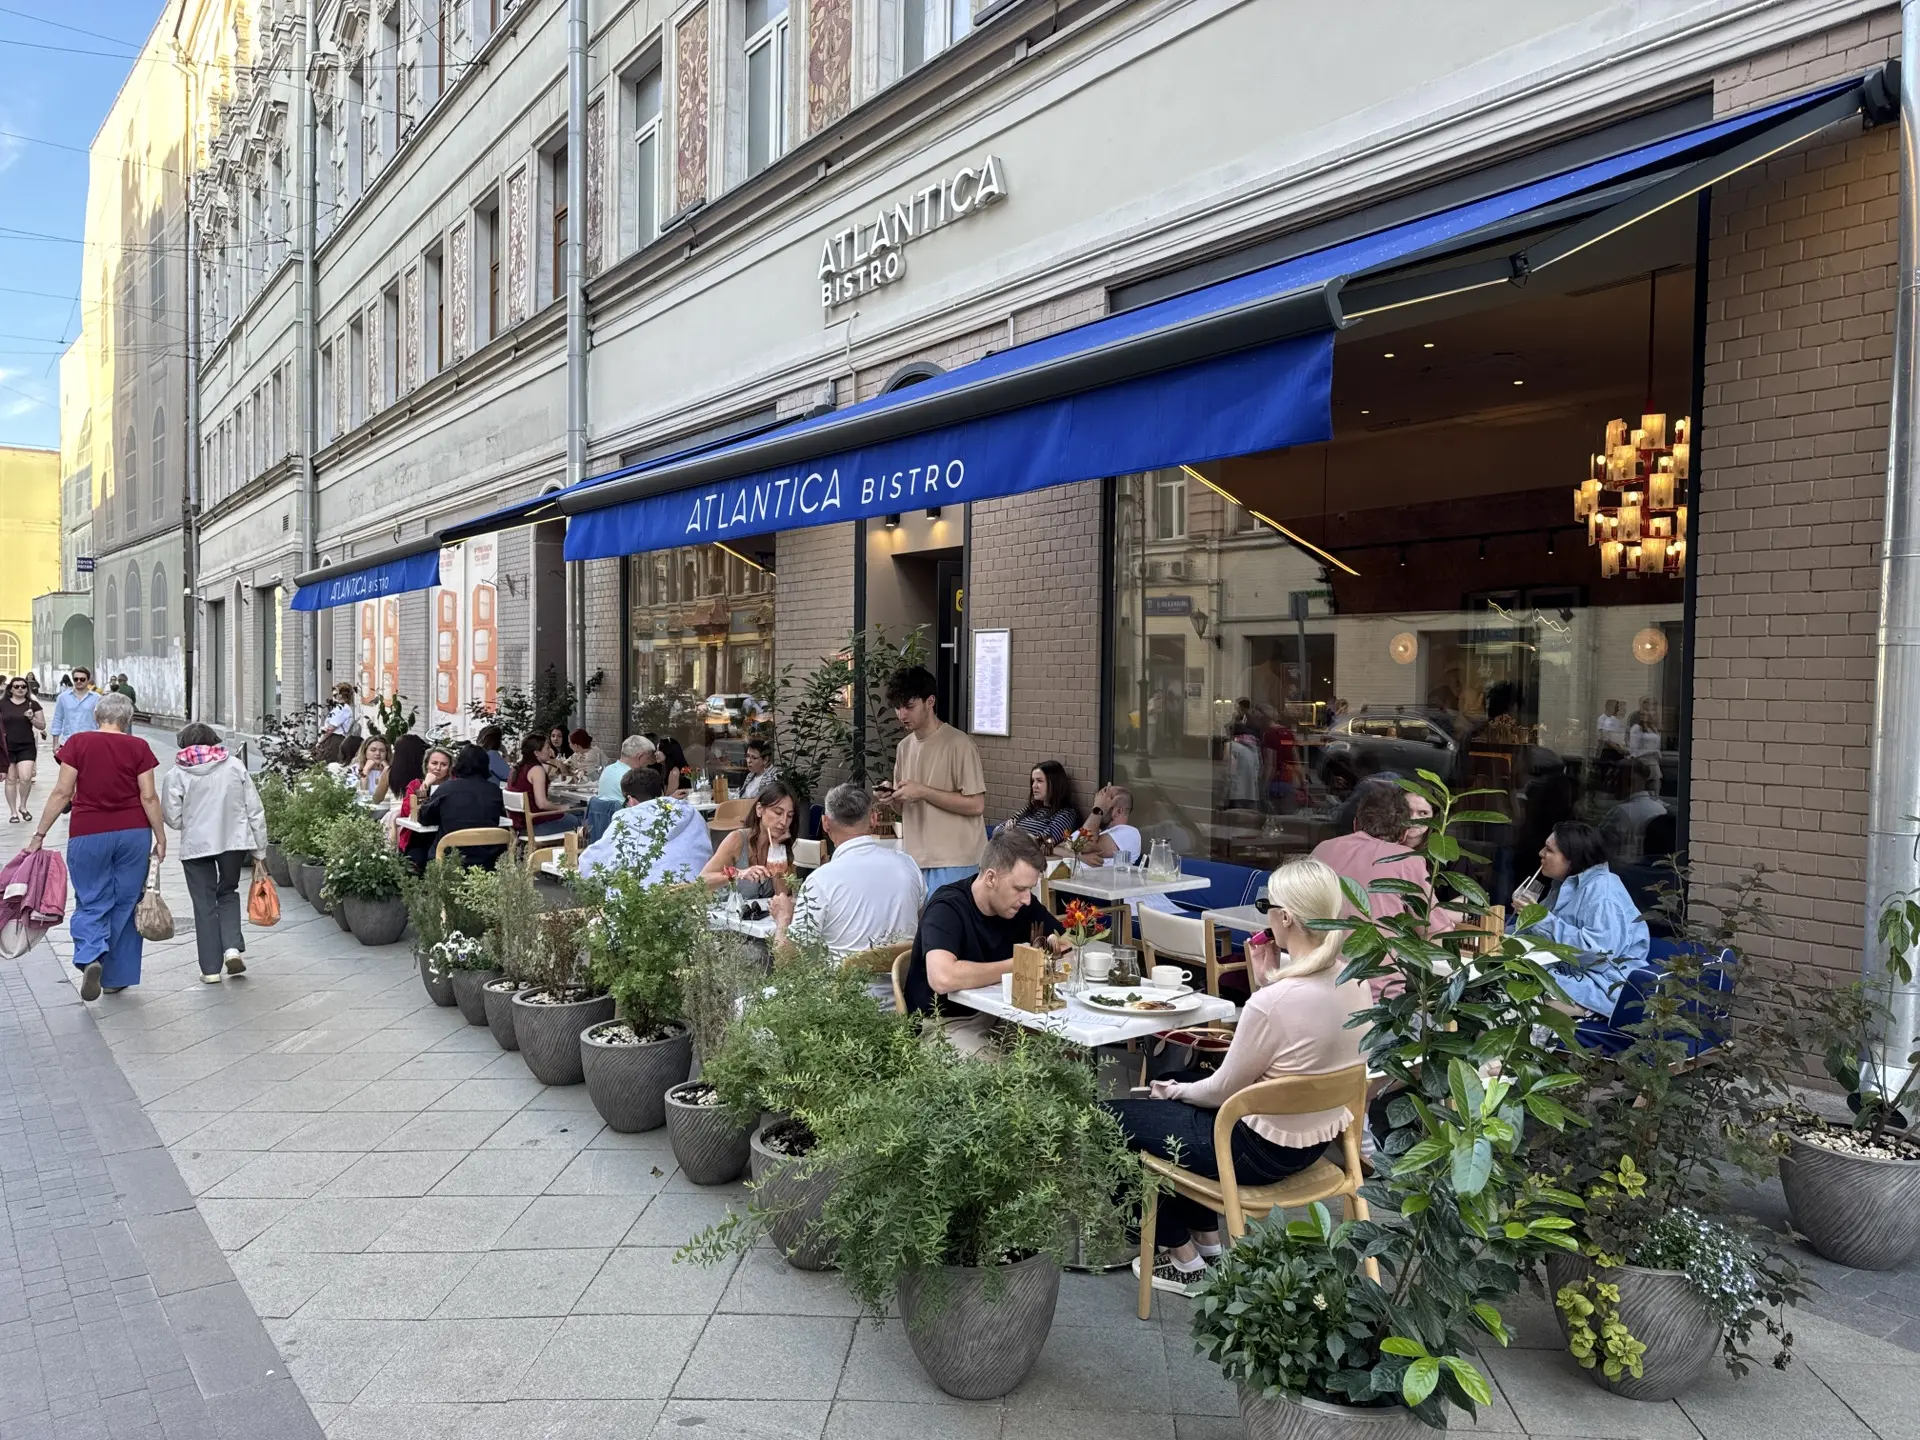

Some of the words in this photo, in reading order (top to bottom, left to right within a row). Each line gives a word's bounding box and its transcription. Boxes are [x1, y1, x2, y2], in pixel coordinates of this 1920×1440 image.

[817, 154, 1004, 280] ATLANTICA
[821, 252, 903, 308] BISTRO
[685, 468, 841, 535] ATLANTICA
[861, 459, 965, 505] BISTRO
[329, 574, 367, 602] ATLANTICA
